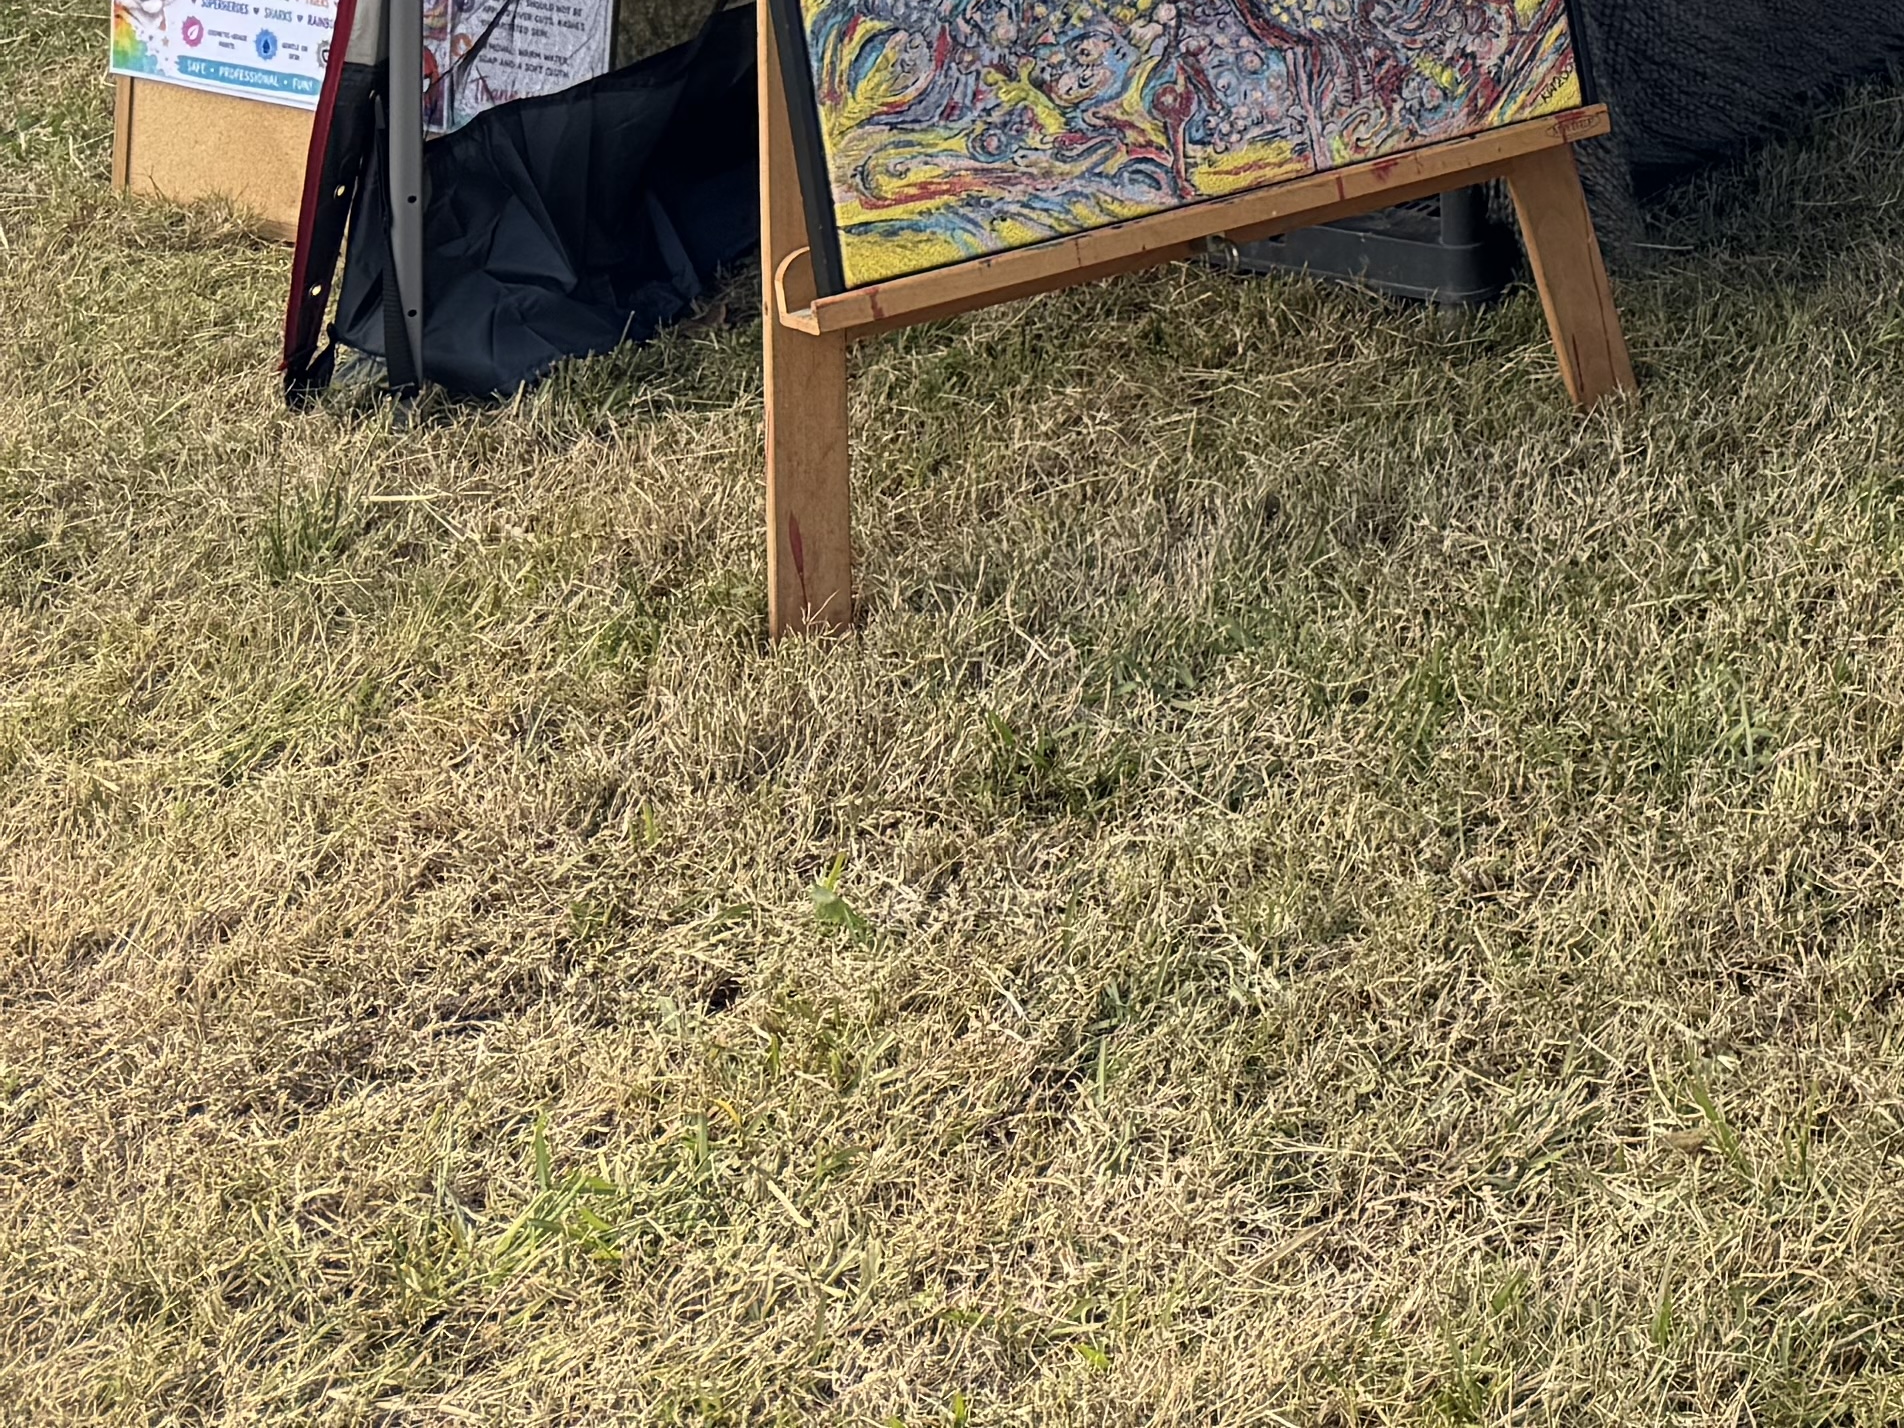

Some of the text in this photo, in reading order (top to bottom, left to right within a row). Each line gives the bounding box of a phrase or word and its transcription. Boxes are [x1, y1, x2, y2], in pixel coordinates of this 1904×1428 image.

[264, 6, 293, 23] SHARKS
[187, 60, 207, 75] SAFE
[218, 65, 280, 88] PROFESSIONAL
